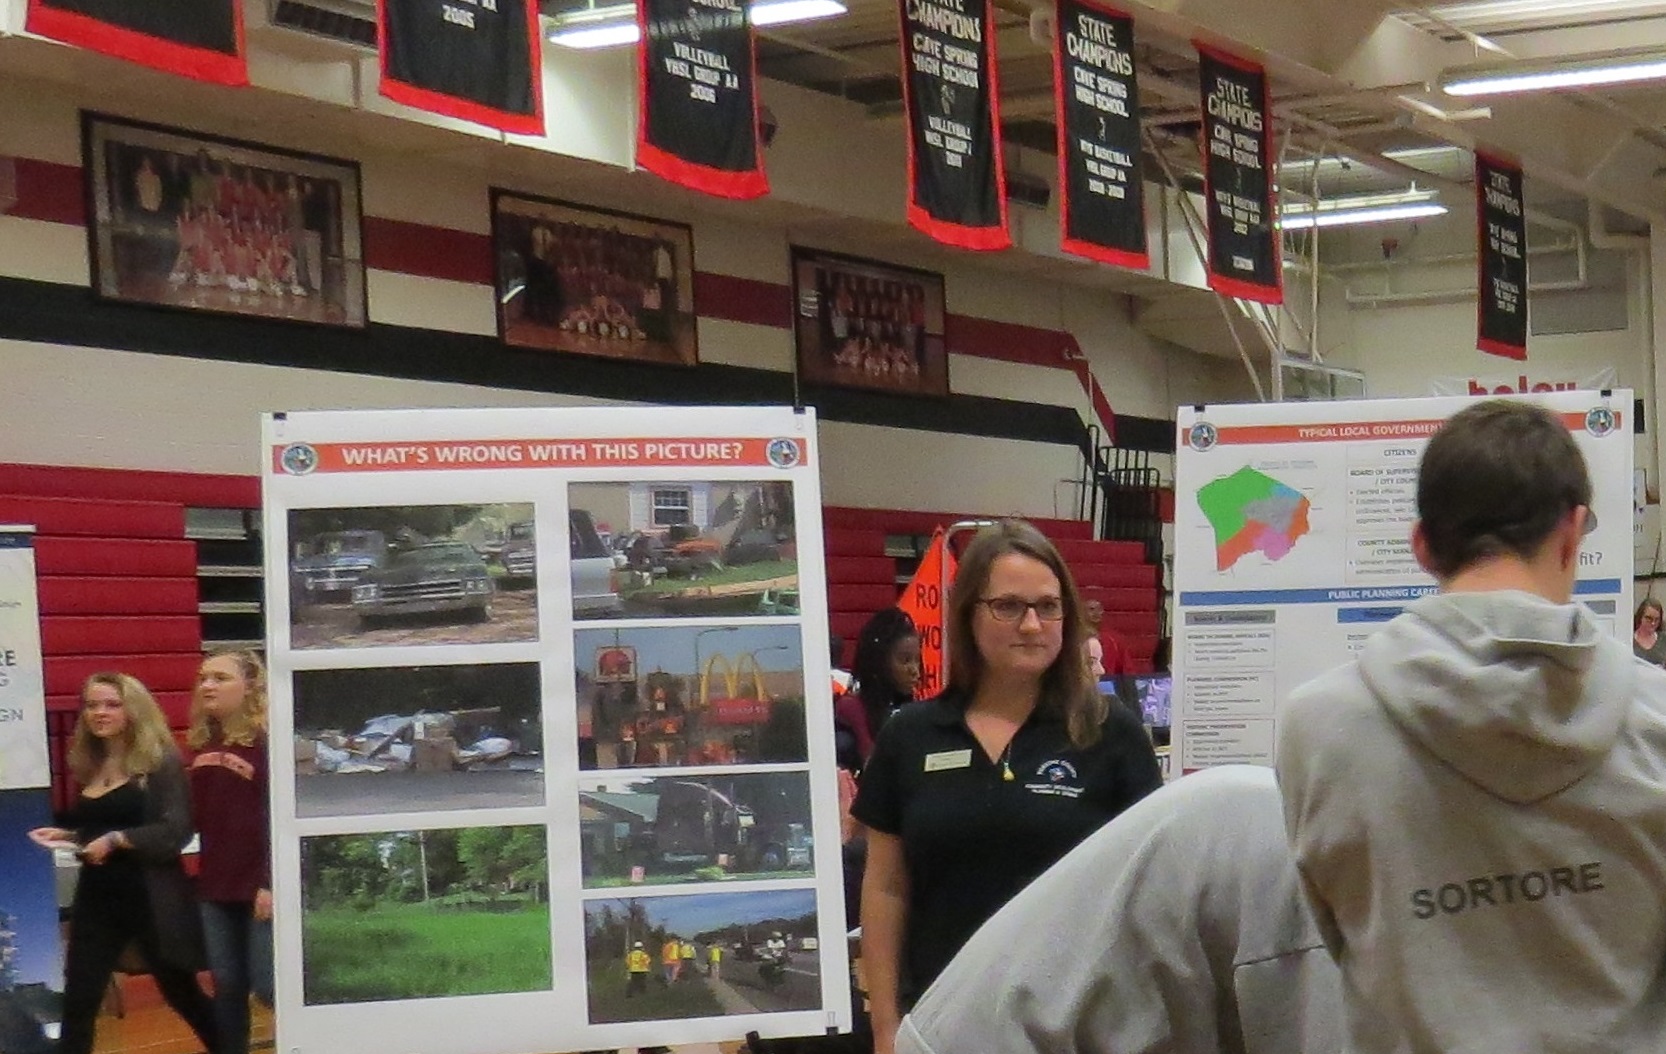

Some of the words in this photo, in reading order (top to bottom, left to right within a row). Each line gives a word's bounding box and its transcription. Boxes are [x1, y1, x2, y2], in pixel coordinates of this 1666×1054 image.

[906, 2, 982, 43] CHAMPIONS
[1078, 14, 1117, 48] STATE
[944, 44, 979, 70] SPRING
[1066, 32, 1133, 76] CHAMPIONS
[912, 52, 941, 77] HIGH
[942, 62, 979, 89] SCHOOL
[1097, 76, 1128, 99] SPRING
[1216, 78, 1249, 106] STATE
[1074, 84, 1095, 106] HIGH
[1096, 93, 1130, 118] SCHOOL
[1298, 426, 1338, 438] TYPICAL
[1340, 425, 1369, 437] LOCAL
[342, 445, 429, 466] WHAT'S
[435, 444, 523, 464] WRONG
[528, 443, 587, 462] WITH
[591, 442, 639, 461] THIS
[645, 440, 744, 460] PICTURE?
[1383, 448, 1417, 457] CITIZENS
[1579, 551, 1603, 566] fit?
[916, 584, 938, 609] RO
[1328, 589, 1360, 600] PUBLIC
[1362, 588, 1409, 599] PLANNING
[1411, 861, 1605, 920] SORTORE
